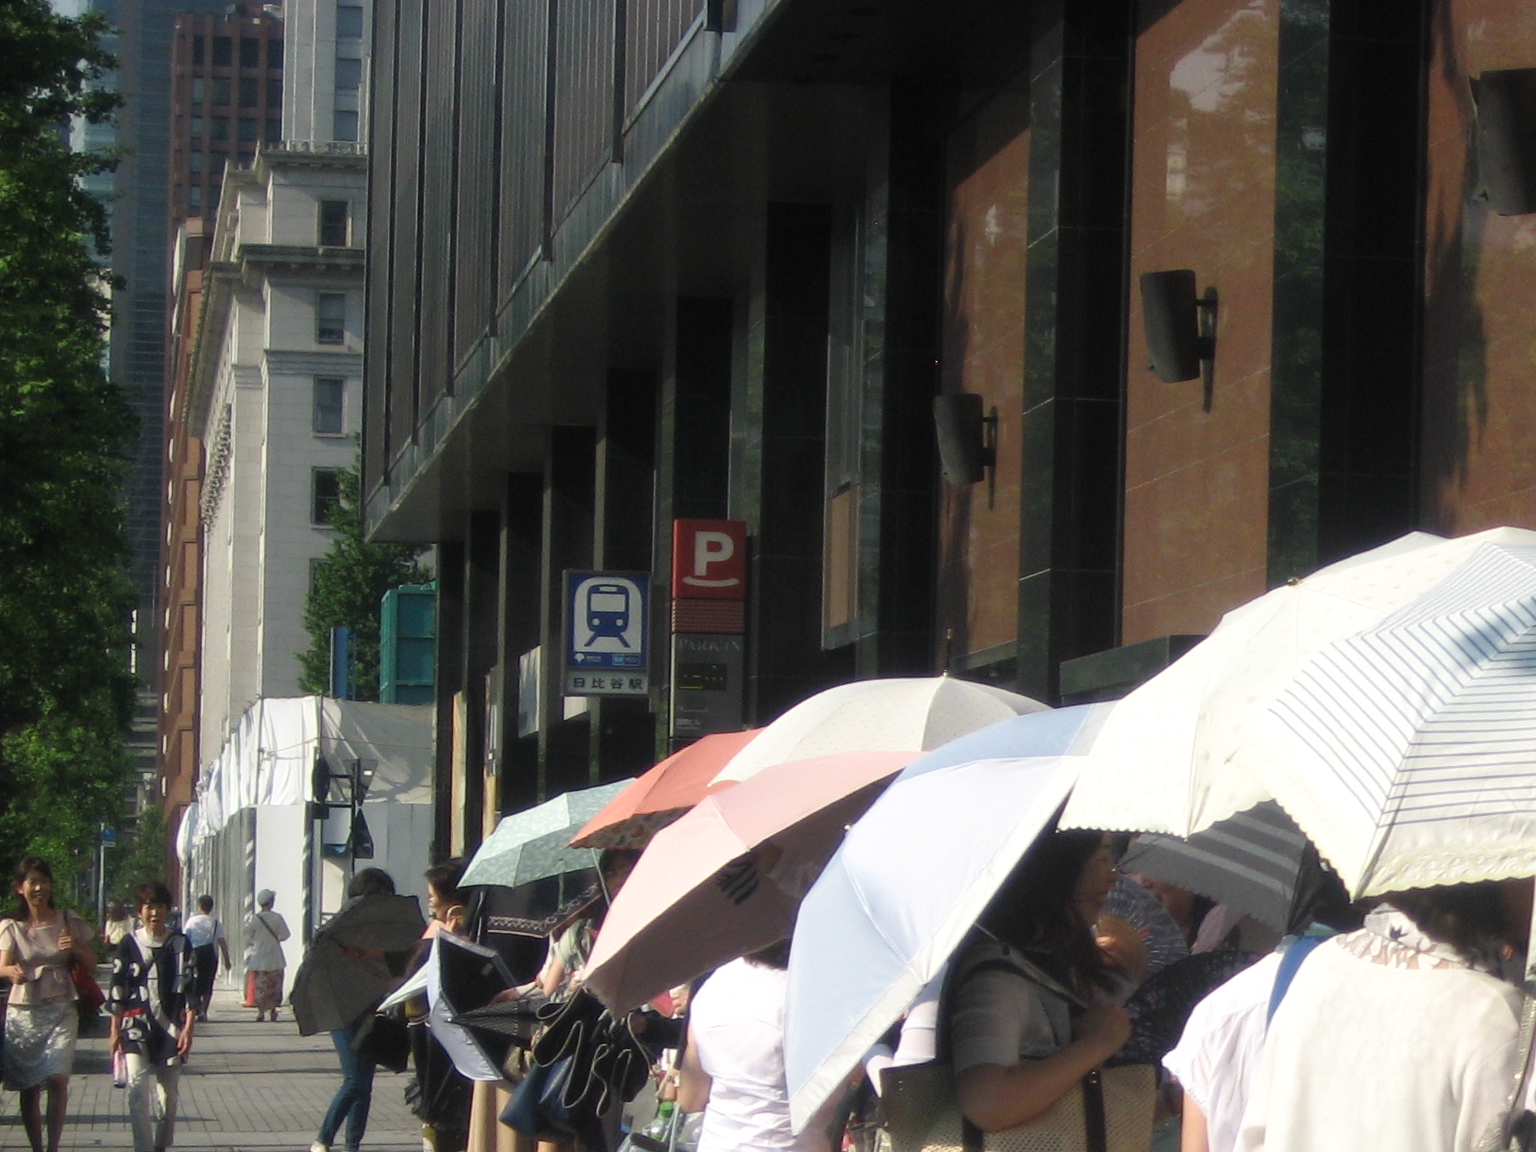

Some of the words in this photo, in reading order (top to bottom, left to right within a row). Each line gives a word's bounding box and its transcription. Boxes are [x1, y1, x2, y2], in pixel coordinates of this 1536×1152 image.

[694, 531, 735, 577] P
[573, 677, 643, 690] 日比谷駅
